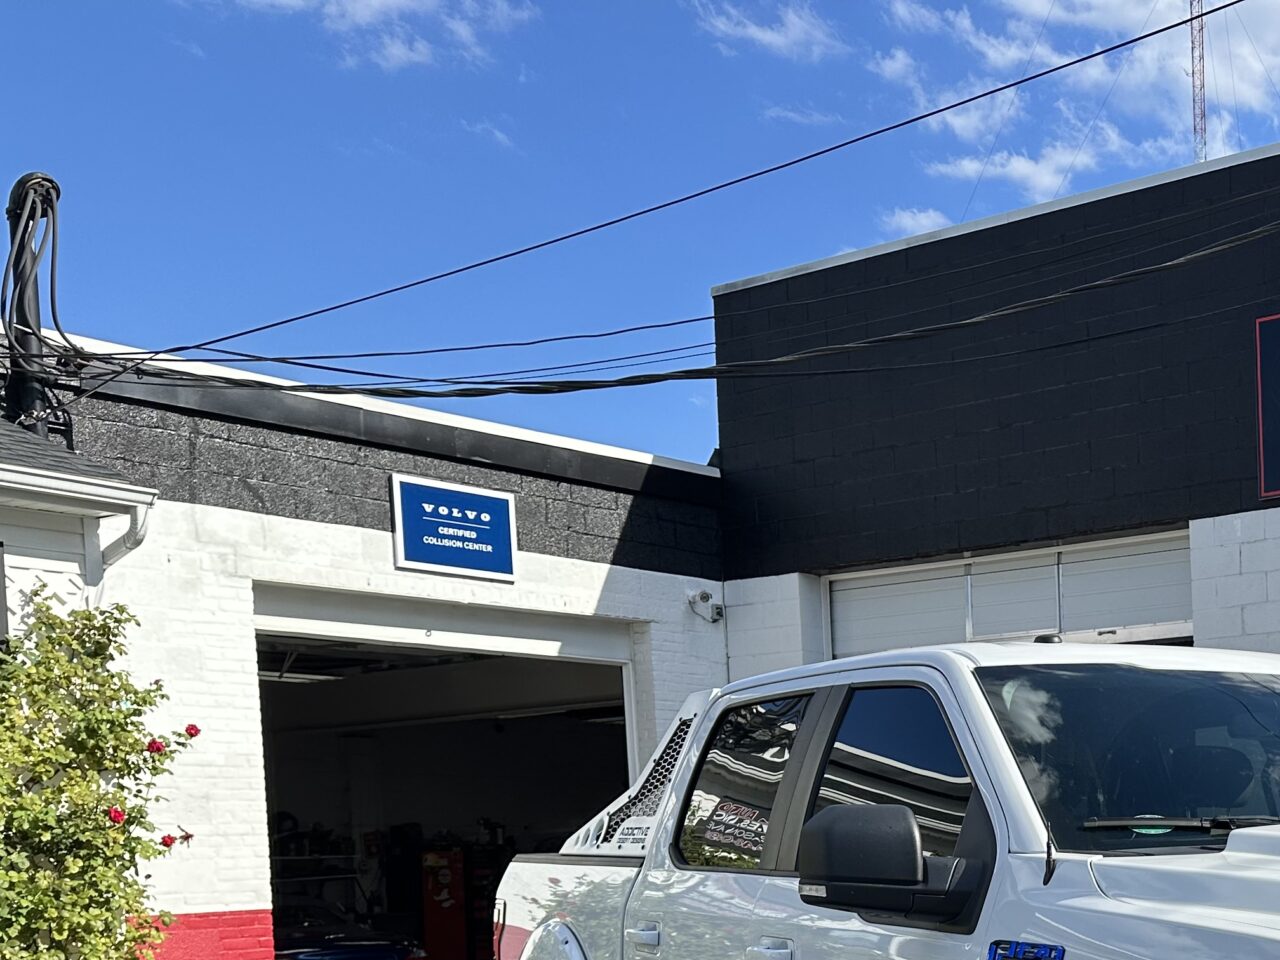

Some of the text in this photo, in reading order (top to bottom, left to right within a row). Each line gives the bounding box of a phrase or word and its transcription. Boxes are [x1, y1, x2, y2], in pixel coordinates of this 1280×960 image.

[422, 503, 491, 521] VOLVO
[438, 526, 477, 538] CERTIFIED
[423, 536, 493, 553] COLLISION CENTER
